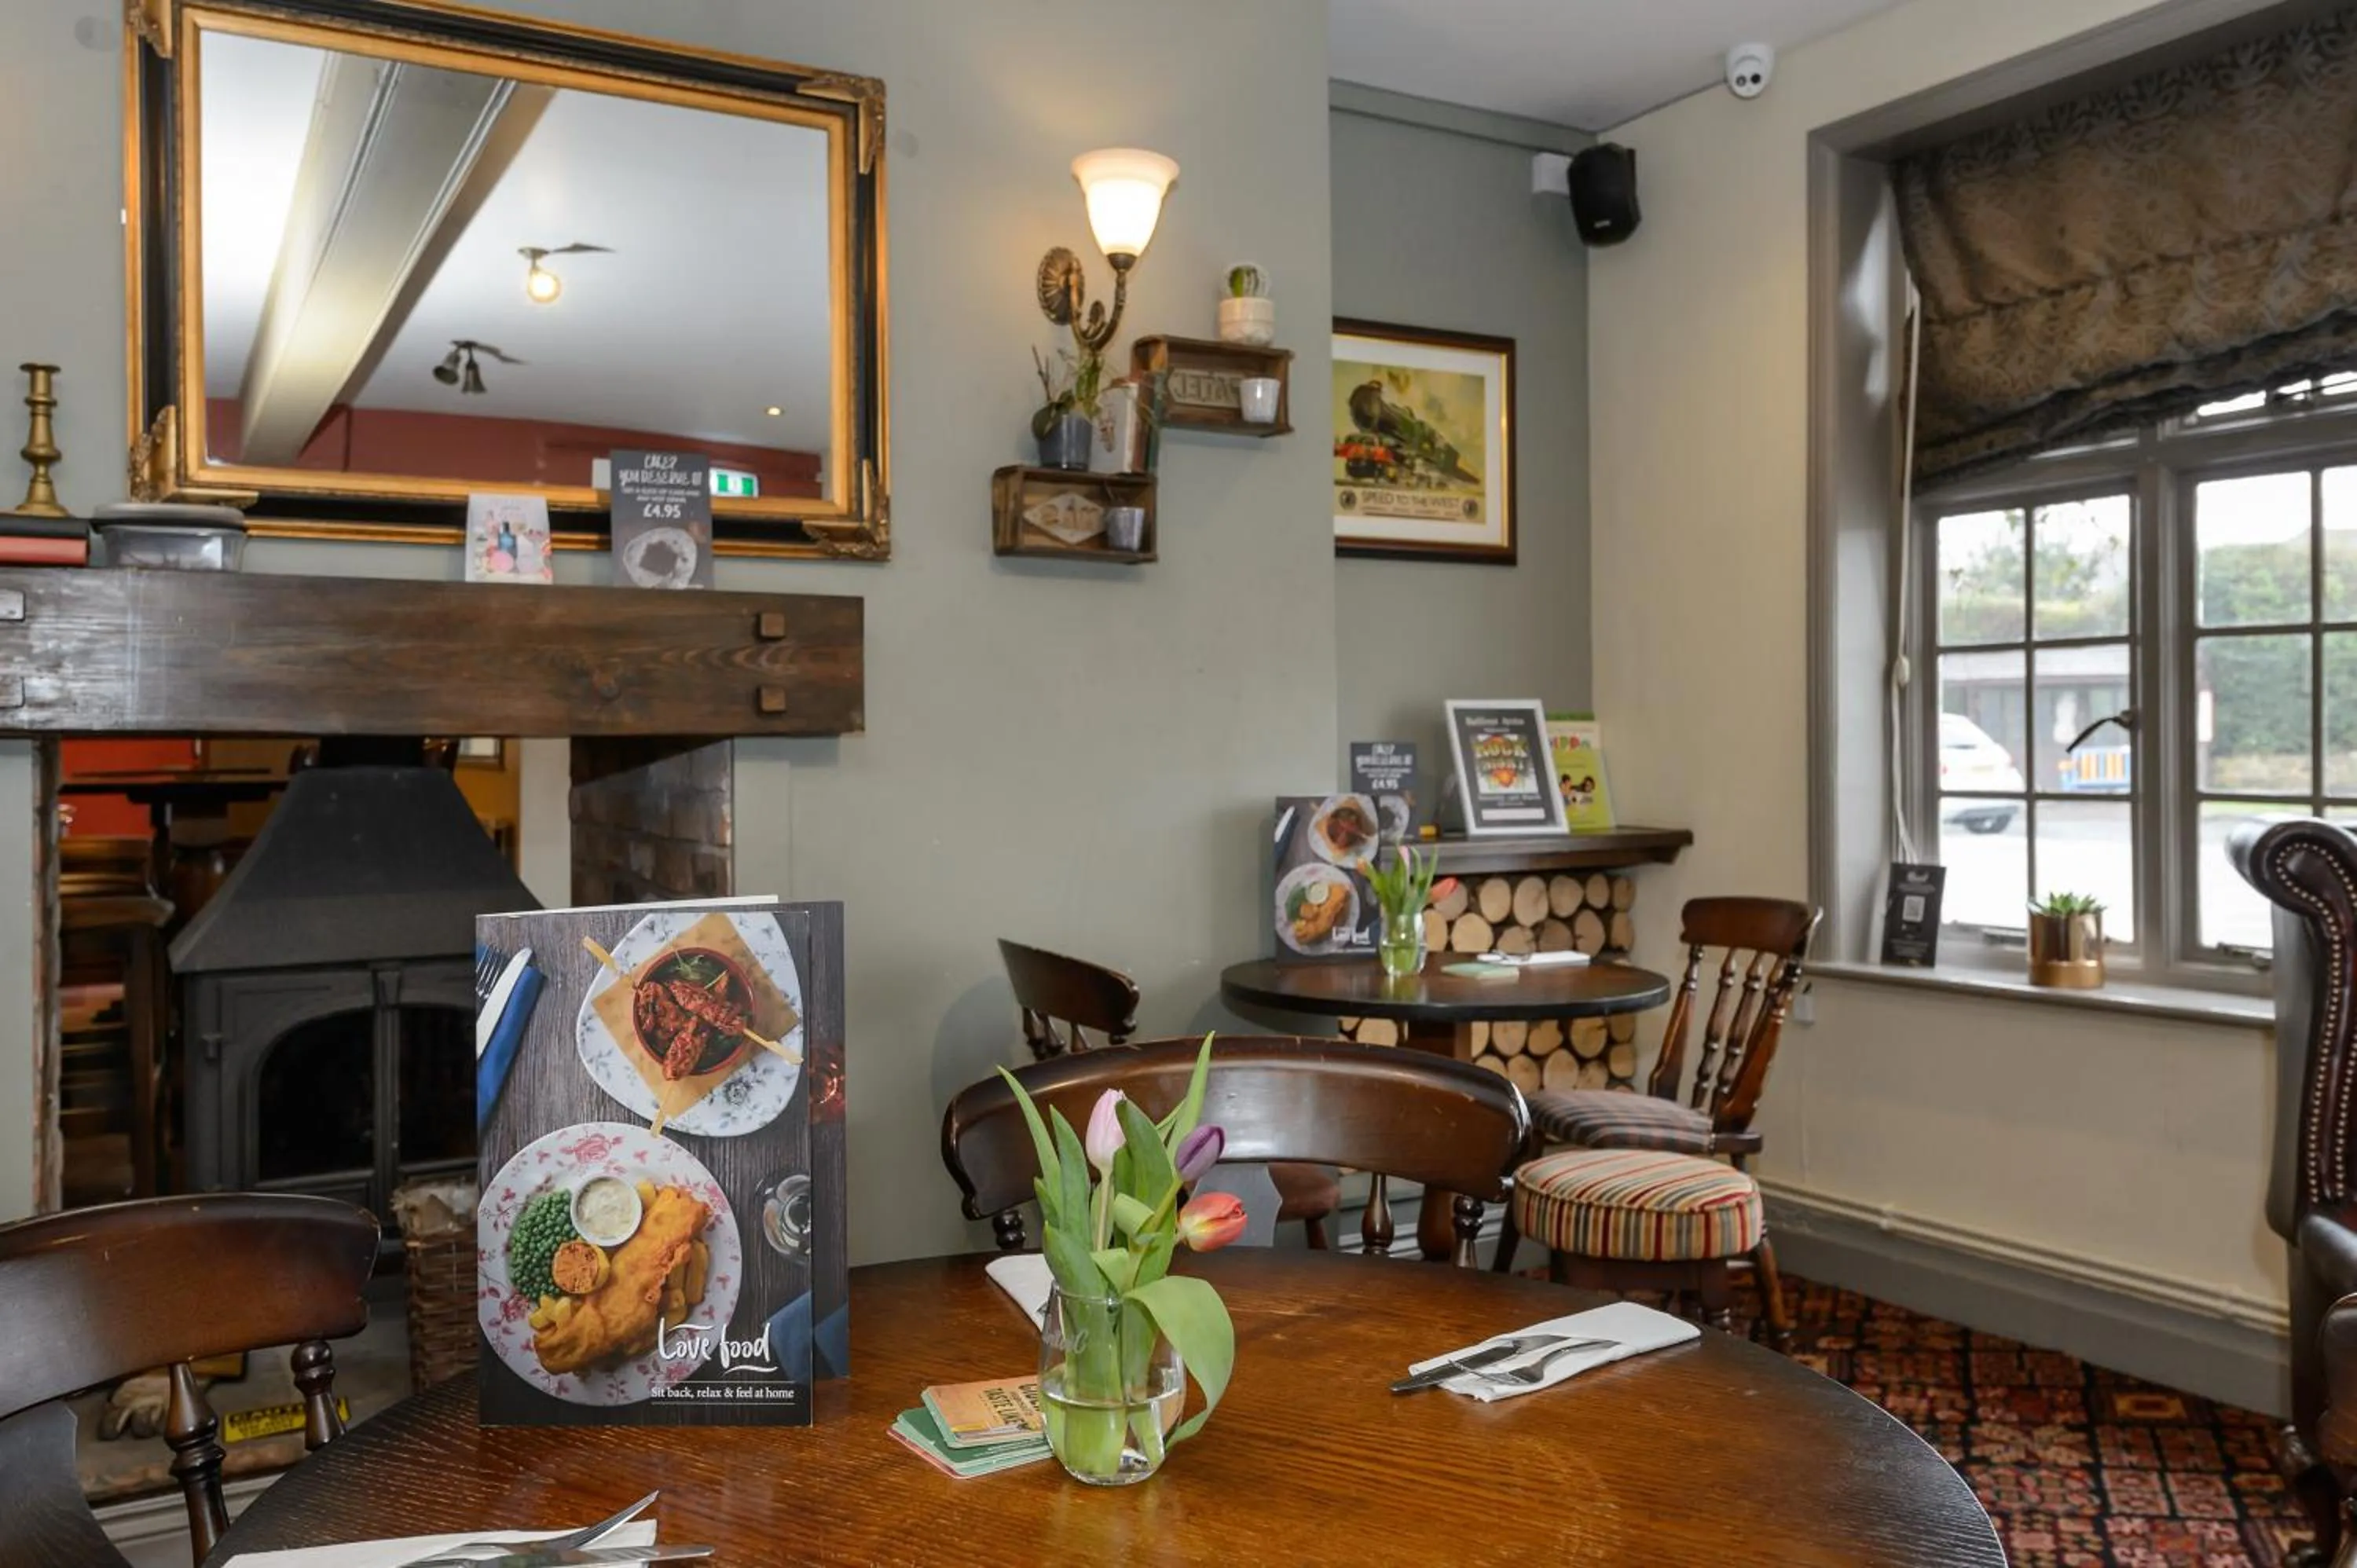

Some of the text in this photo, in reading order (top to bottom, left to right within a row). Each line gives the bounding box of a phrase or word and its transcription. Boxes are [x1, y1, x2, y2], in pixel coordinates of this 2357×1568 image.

[643, 504, 681, 518] £4.95
[658, 1317, 771, 1369] Love food
[651, 1387, 794, 1399] Sit back, relax & feel at home
